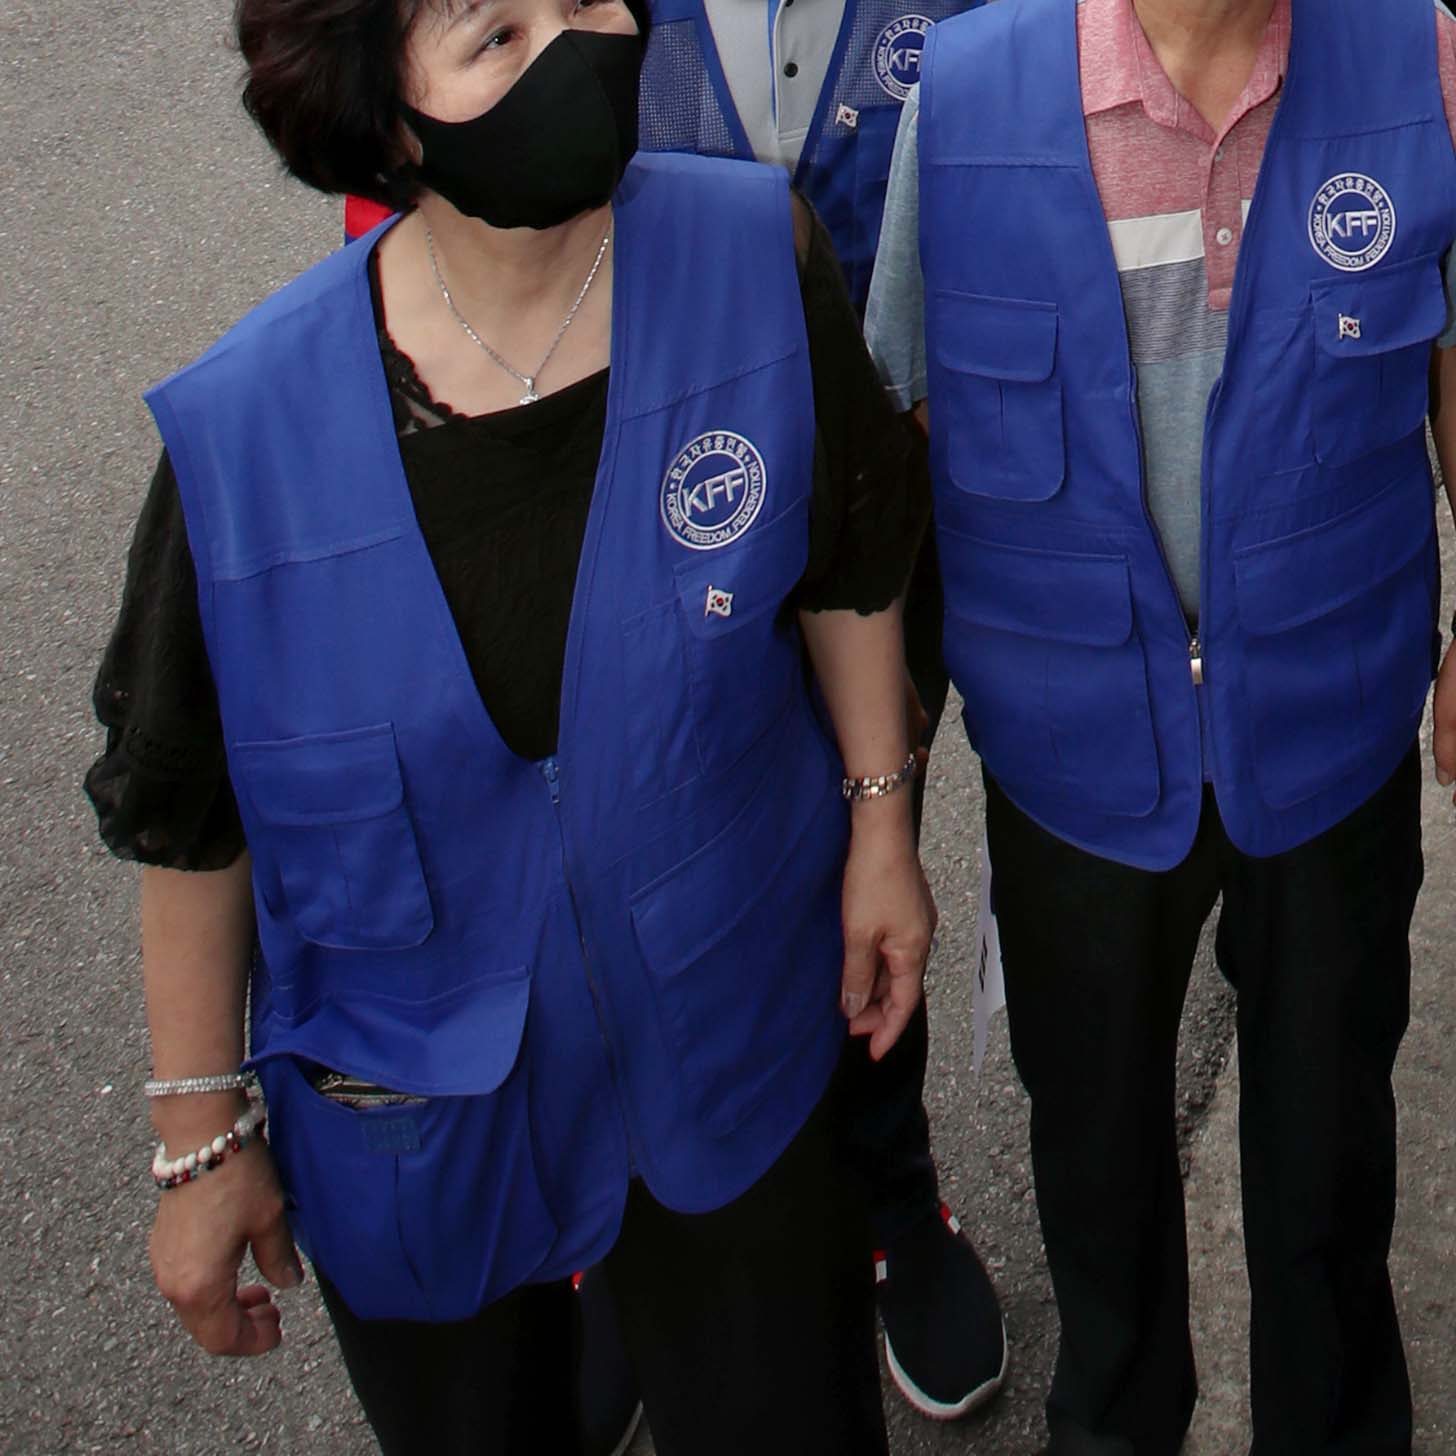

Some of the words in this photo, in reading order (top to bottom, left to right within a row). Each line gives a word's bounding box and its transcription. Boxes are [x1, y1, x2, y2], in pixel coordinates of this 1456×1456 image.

[881, 75, 910, 97] FREEDO
[1318, 176, 1385, 207] 한국자유총연맹
[1312, 213, 1325, 250] KOREA
[1324, 246, 1364, 268] FREEDOM
[1364, 208, 1391, 263] FEDERATION
[1326, 209, 1378, 240] KFF
[669, 435, 749, 482] 한국자유총연맹
[665, 492, 683, 531] KOREA
[681, 524, 734, 545] FREEDOM
[732, 460, 762, 537] FEDERATION
[681, 467, 745, 518] KFF
